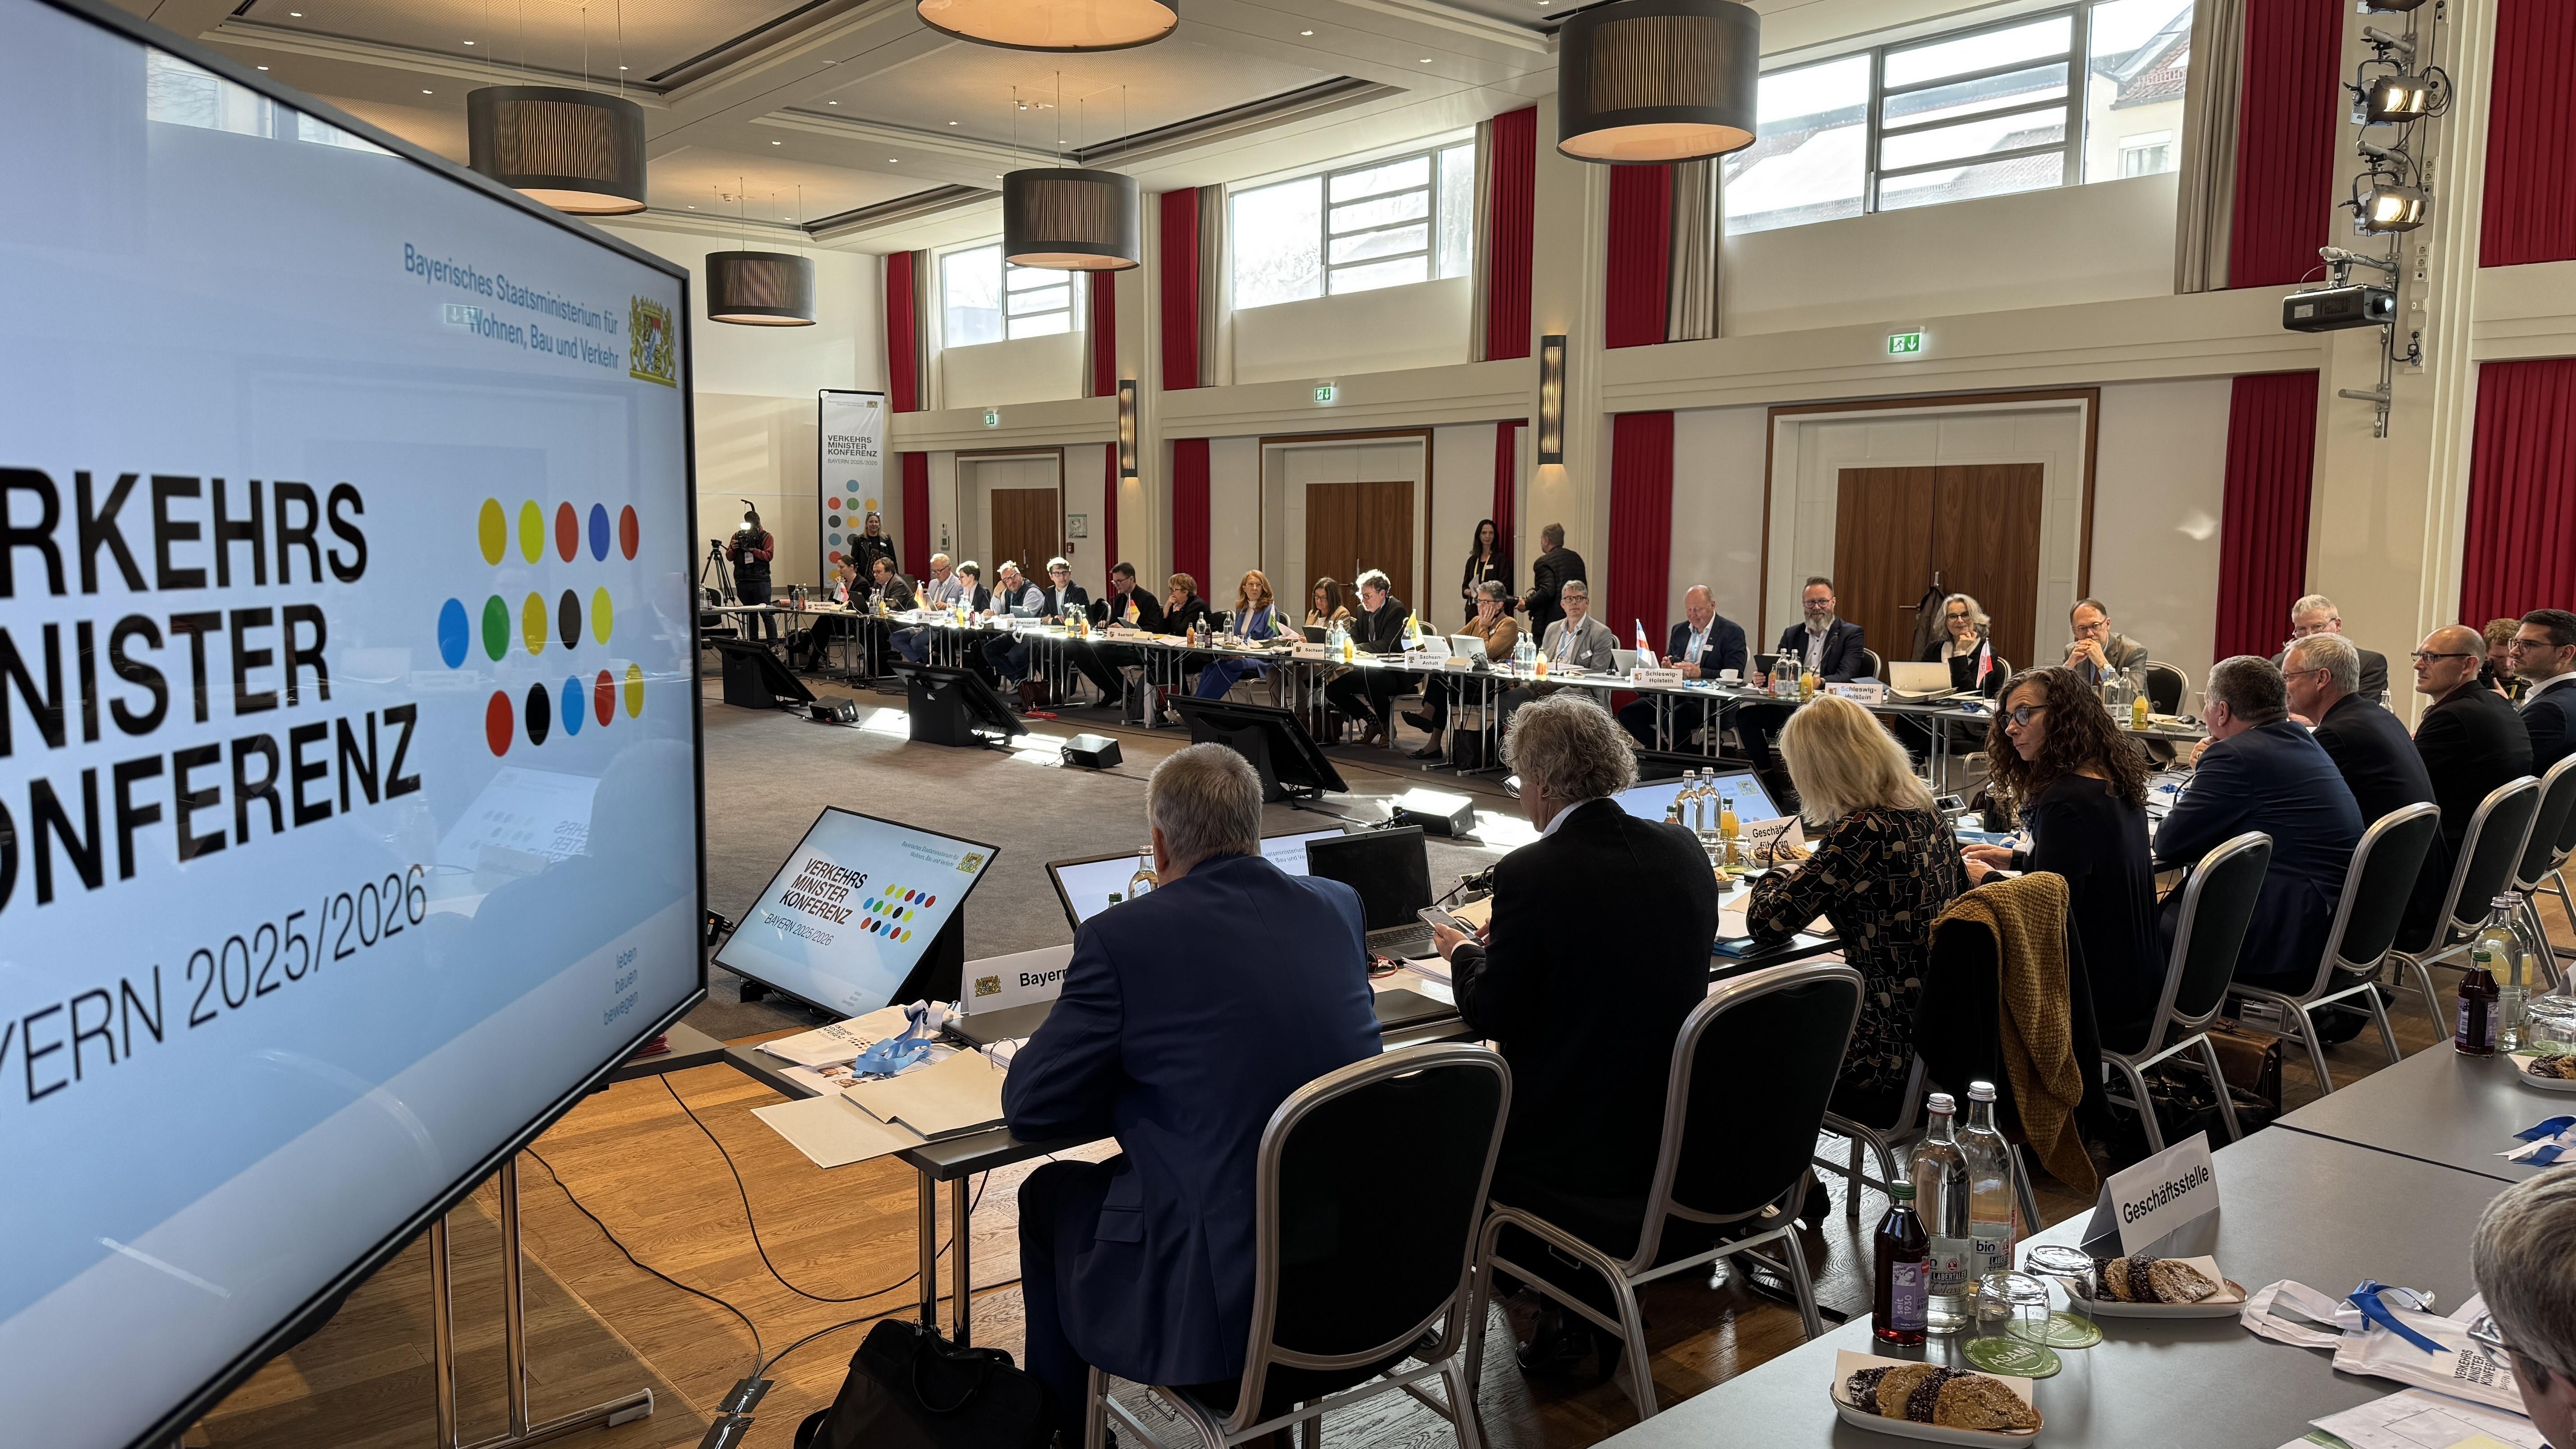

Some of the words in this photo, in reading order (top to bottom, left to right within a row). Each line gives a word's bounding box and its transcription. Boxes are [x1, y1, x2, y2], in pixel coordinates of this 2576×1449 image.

[404, 243, 493, 297] Bayerisches
[497, 274, 601, 331] Staatsministerium
[603, 309, 618, 335] für
[468, 306, 527, 350] Wohnen,
[530, 324, 553, 352] Bau
[556, 337, 578, 359] und
[580, 339, 619, 369] Verkehr
[828, 435, 872, 443] VERKEHRS
[828, 442, 867, 450] MINISTER
[828, 449, 877, 457] KONFERENZ
[804, 858, 868, 889] VERKEHRS
[791, 874, 849, 904] MINISTER
[779, 889, 853, 925] KONFERENZ
[764, 913, 796, 932] BAYERN
[792, 924, 834, 946] 2025/2026
[186, 864, 427, 1029] 2025/2026
[616, 947, 637, 970] leben
[615, 969, 638, 994] bauen
[603, 991, 638, 1026] bewegen
[2123, 1165, 2209, 1224] Geschäftsstelle
[1976, 1240, 1995, 1252] bio
[1895, 1298, 1903, 1314] seit
[1904, 1295, 1912, 1315] 1930
[1988, 1347, 2033, 1365] ASAM
[2453, 1349, 2474, 1379] VERKEHRS
[2467, 1355, 2485, 1383] MINISTER
